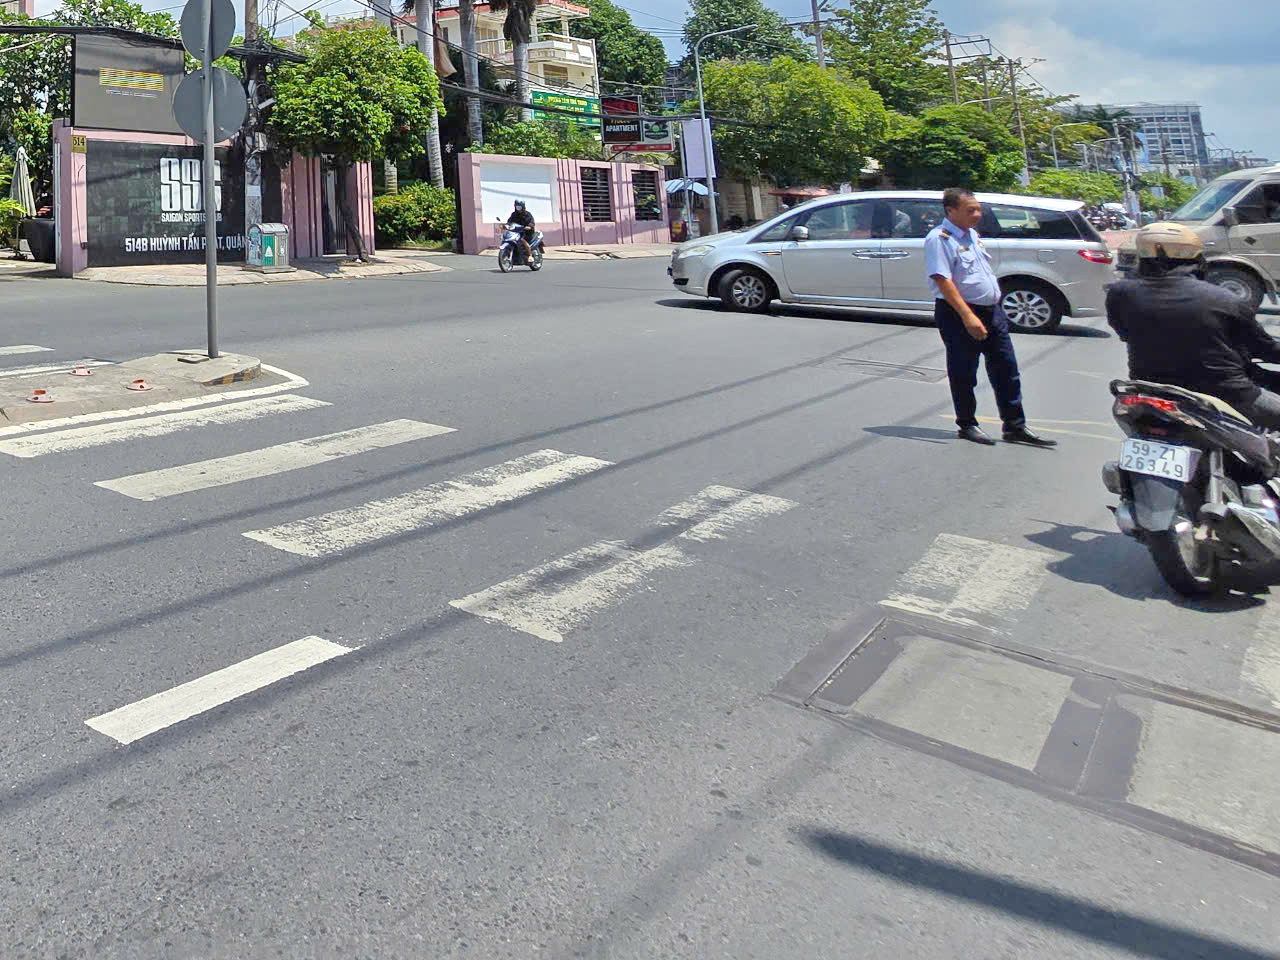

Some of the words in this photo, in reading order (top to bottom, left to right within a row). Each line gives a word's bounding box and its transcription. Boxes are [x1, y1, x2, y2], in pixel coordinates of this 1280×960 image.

[605, 124, 638, 132] APARTMENT
[161, 213, 183, 222] SAIGON
[125, 237, 148, 252] 514B
[150, 233, 180, 252] HUỲNH
[183, 231, 200, 250] TẤN
[1131, 441, 1176, 461] 59-Z1
